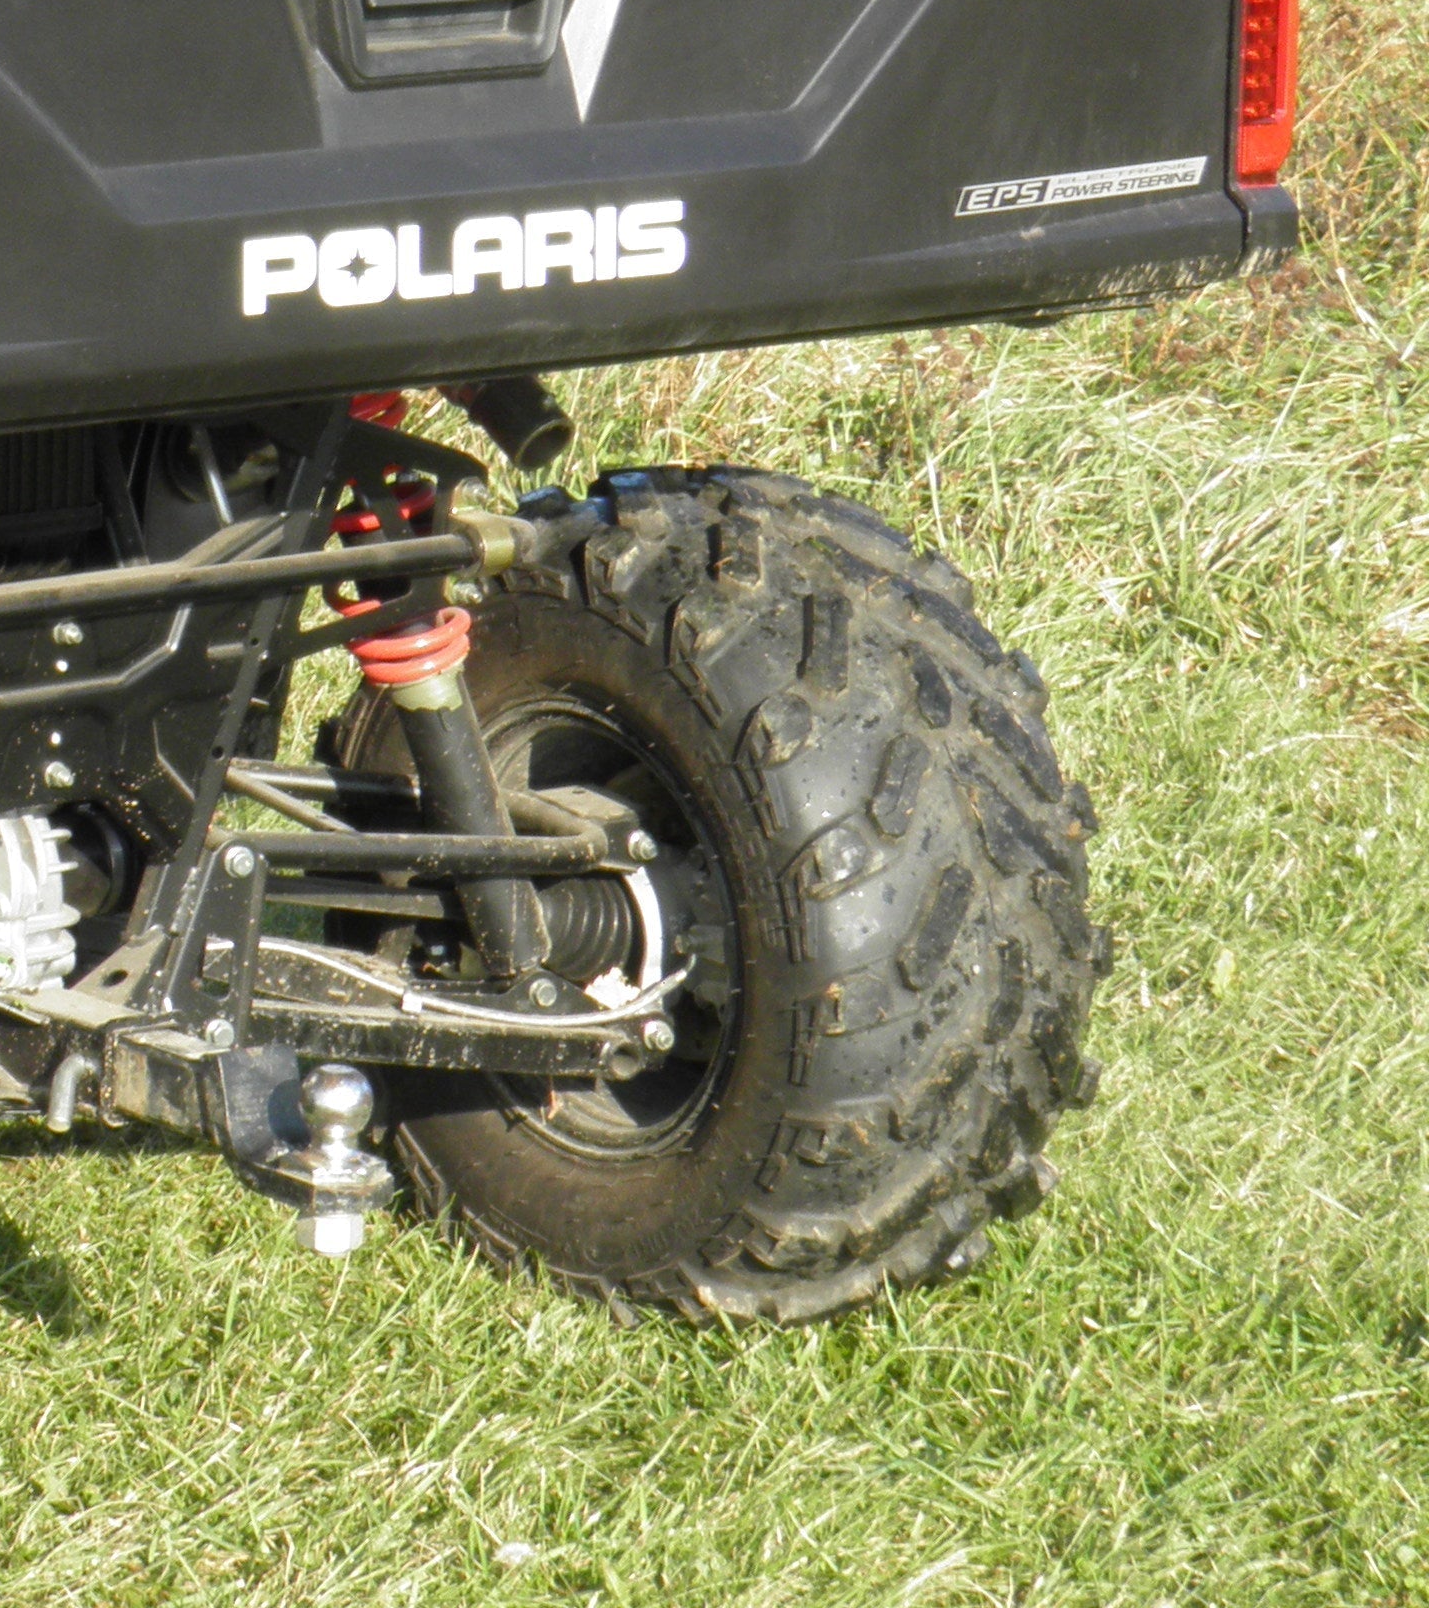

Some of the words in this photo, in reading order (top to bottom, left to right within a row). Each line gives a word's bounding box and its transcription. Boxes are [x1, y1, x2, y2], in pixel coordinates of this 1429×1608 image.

[966, 181, 1043, 211] EPS
[1051, 181, 1112, 200] POWER
[1117, 170, 1197, 192] STEERING
[242, 199, 687, 317] POLARIS
